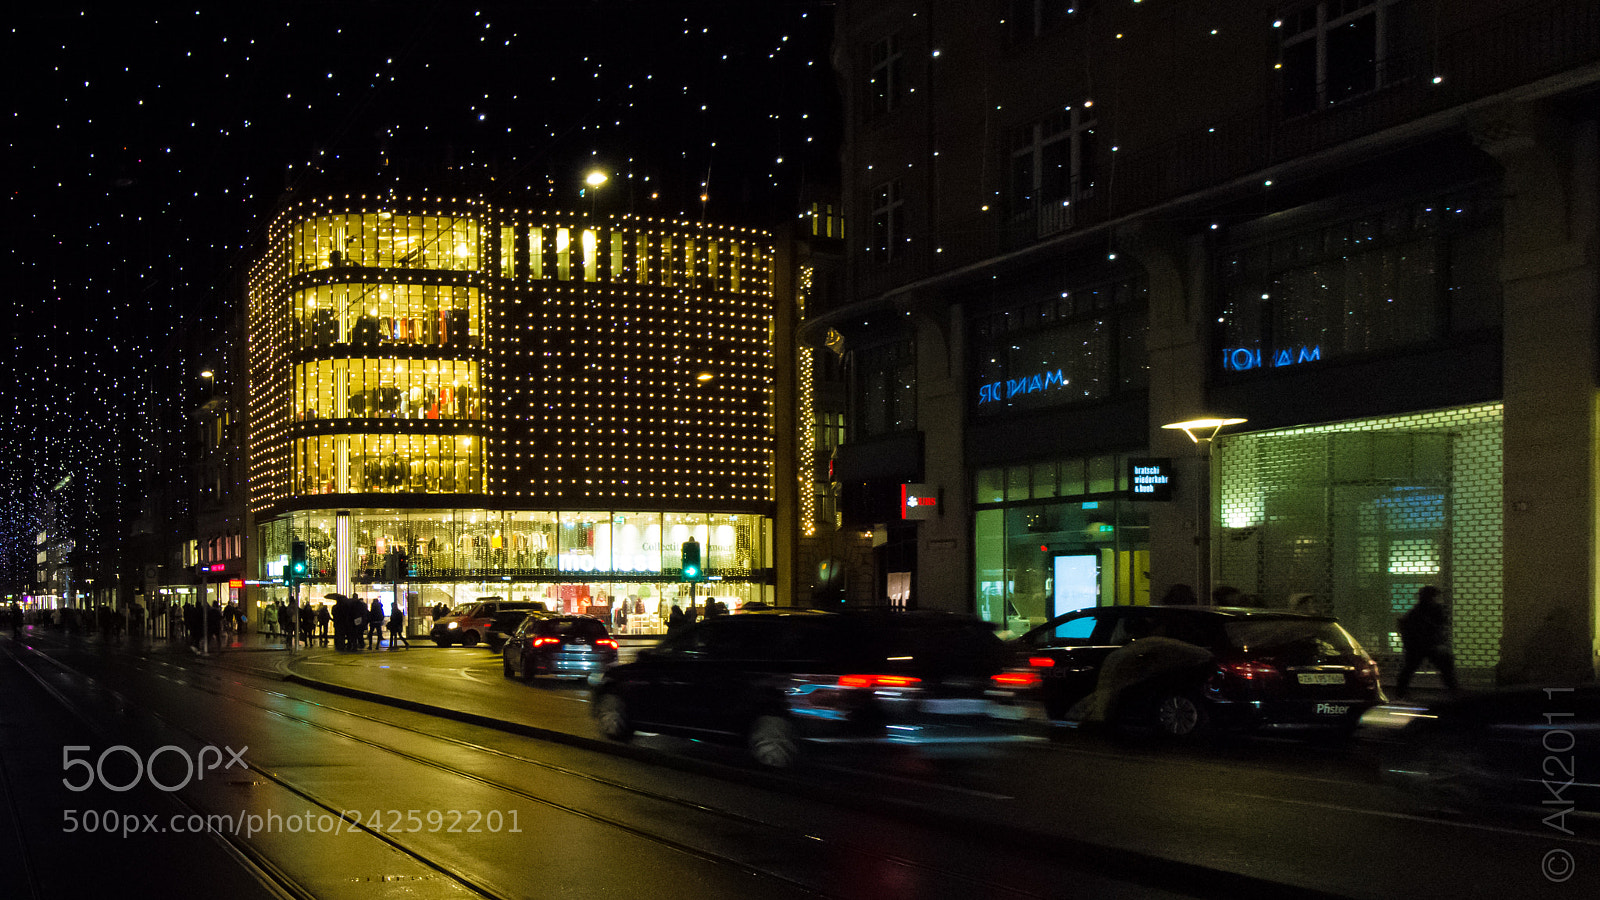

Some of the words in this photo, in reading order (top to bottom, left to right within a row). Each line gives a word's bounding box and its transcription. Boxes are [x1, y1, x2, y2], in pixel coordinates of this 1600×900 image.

[1134, 466, 1160, 475] bratschi
[1134, 475, 1169, 484] wiederkehr
[918, 497, 937, 506] UBS
[1317, 703, 1350, 714] Pfister
